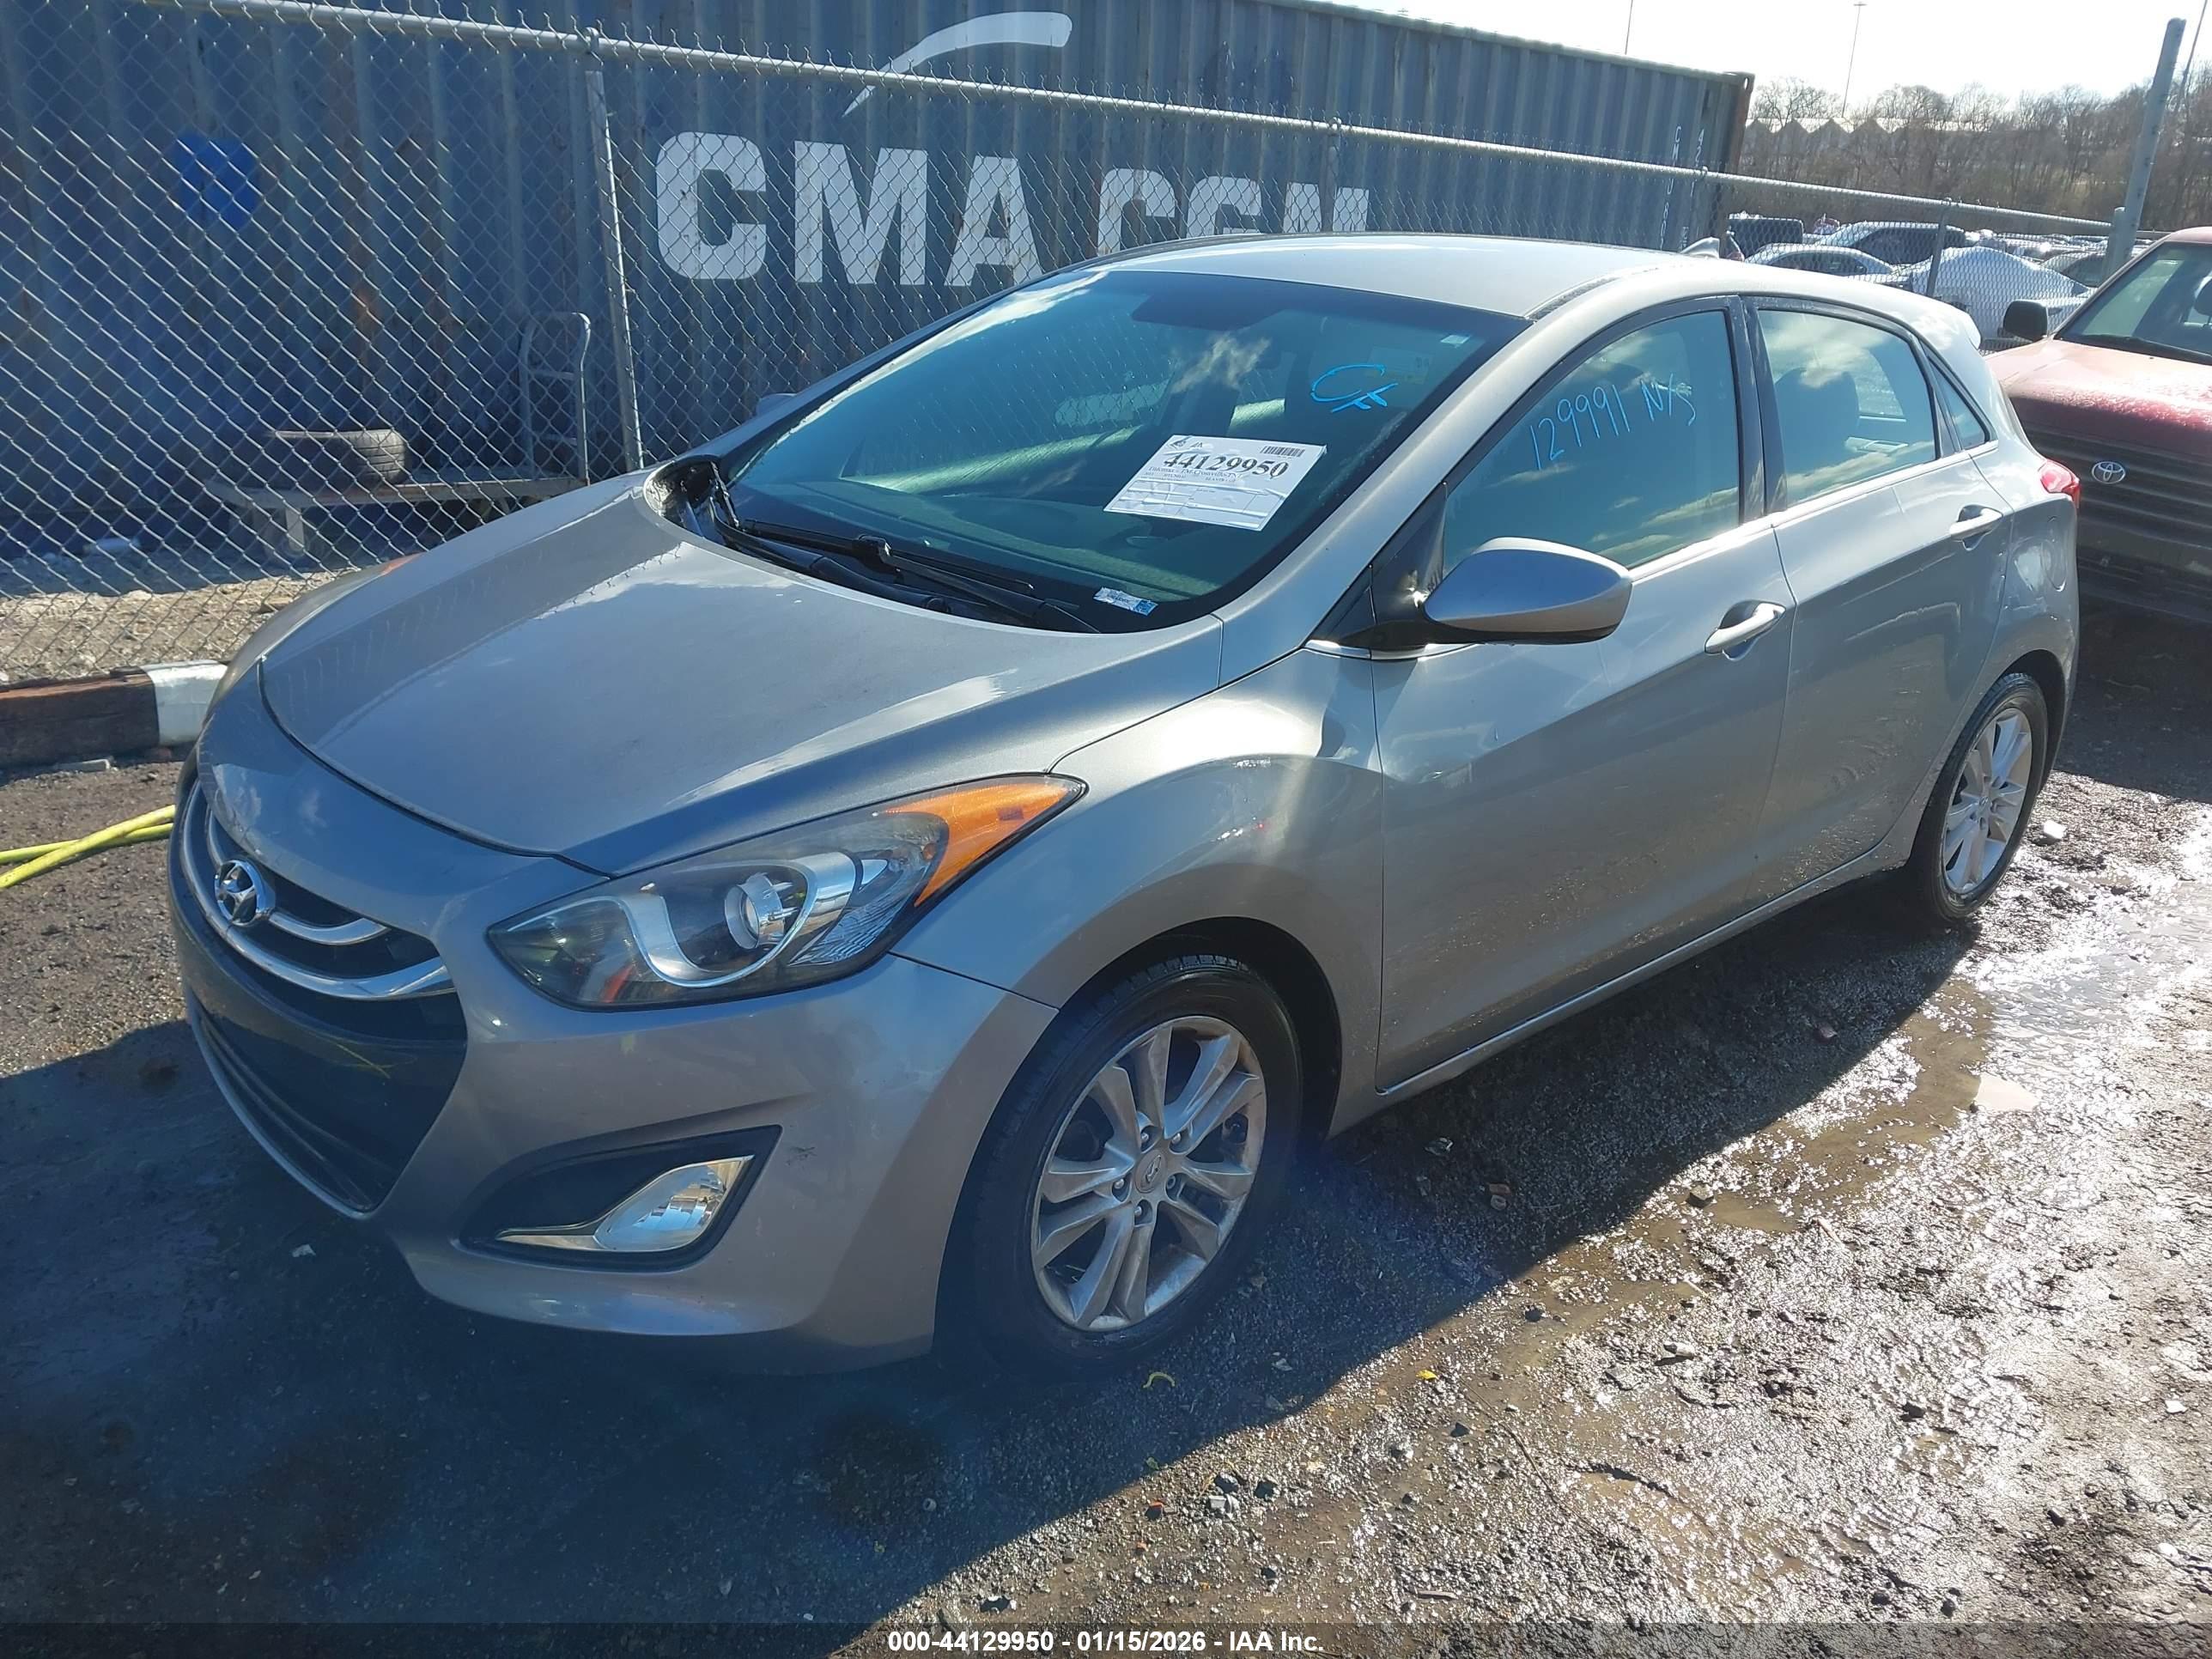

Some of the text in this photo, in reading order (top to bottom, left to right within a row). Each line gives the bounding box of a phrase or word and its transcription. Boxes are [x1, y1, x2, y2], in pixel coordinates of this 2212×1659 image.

[1666, 125, 1682, 195] CMU
[1689, 128, 1705, 198] 421
[657, 131, 1044, 287] CMA
[1530, 384, 1630, 471] 129991
[1164, 453, 1289, 482] 44129950
